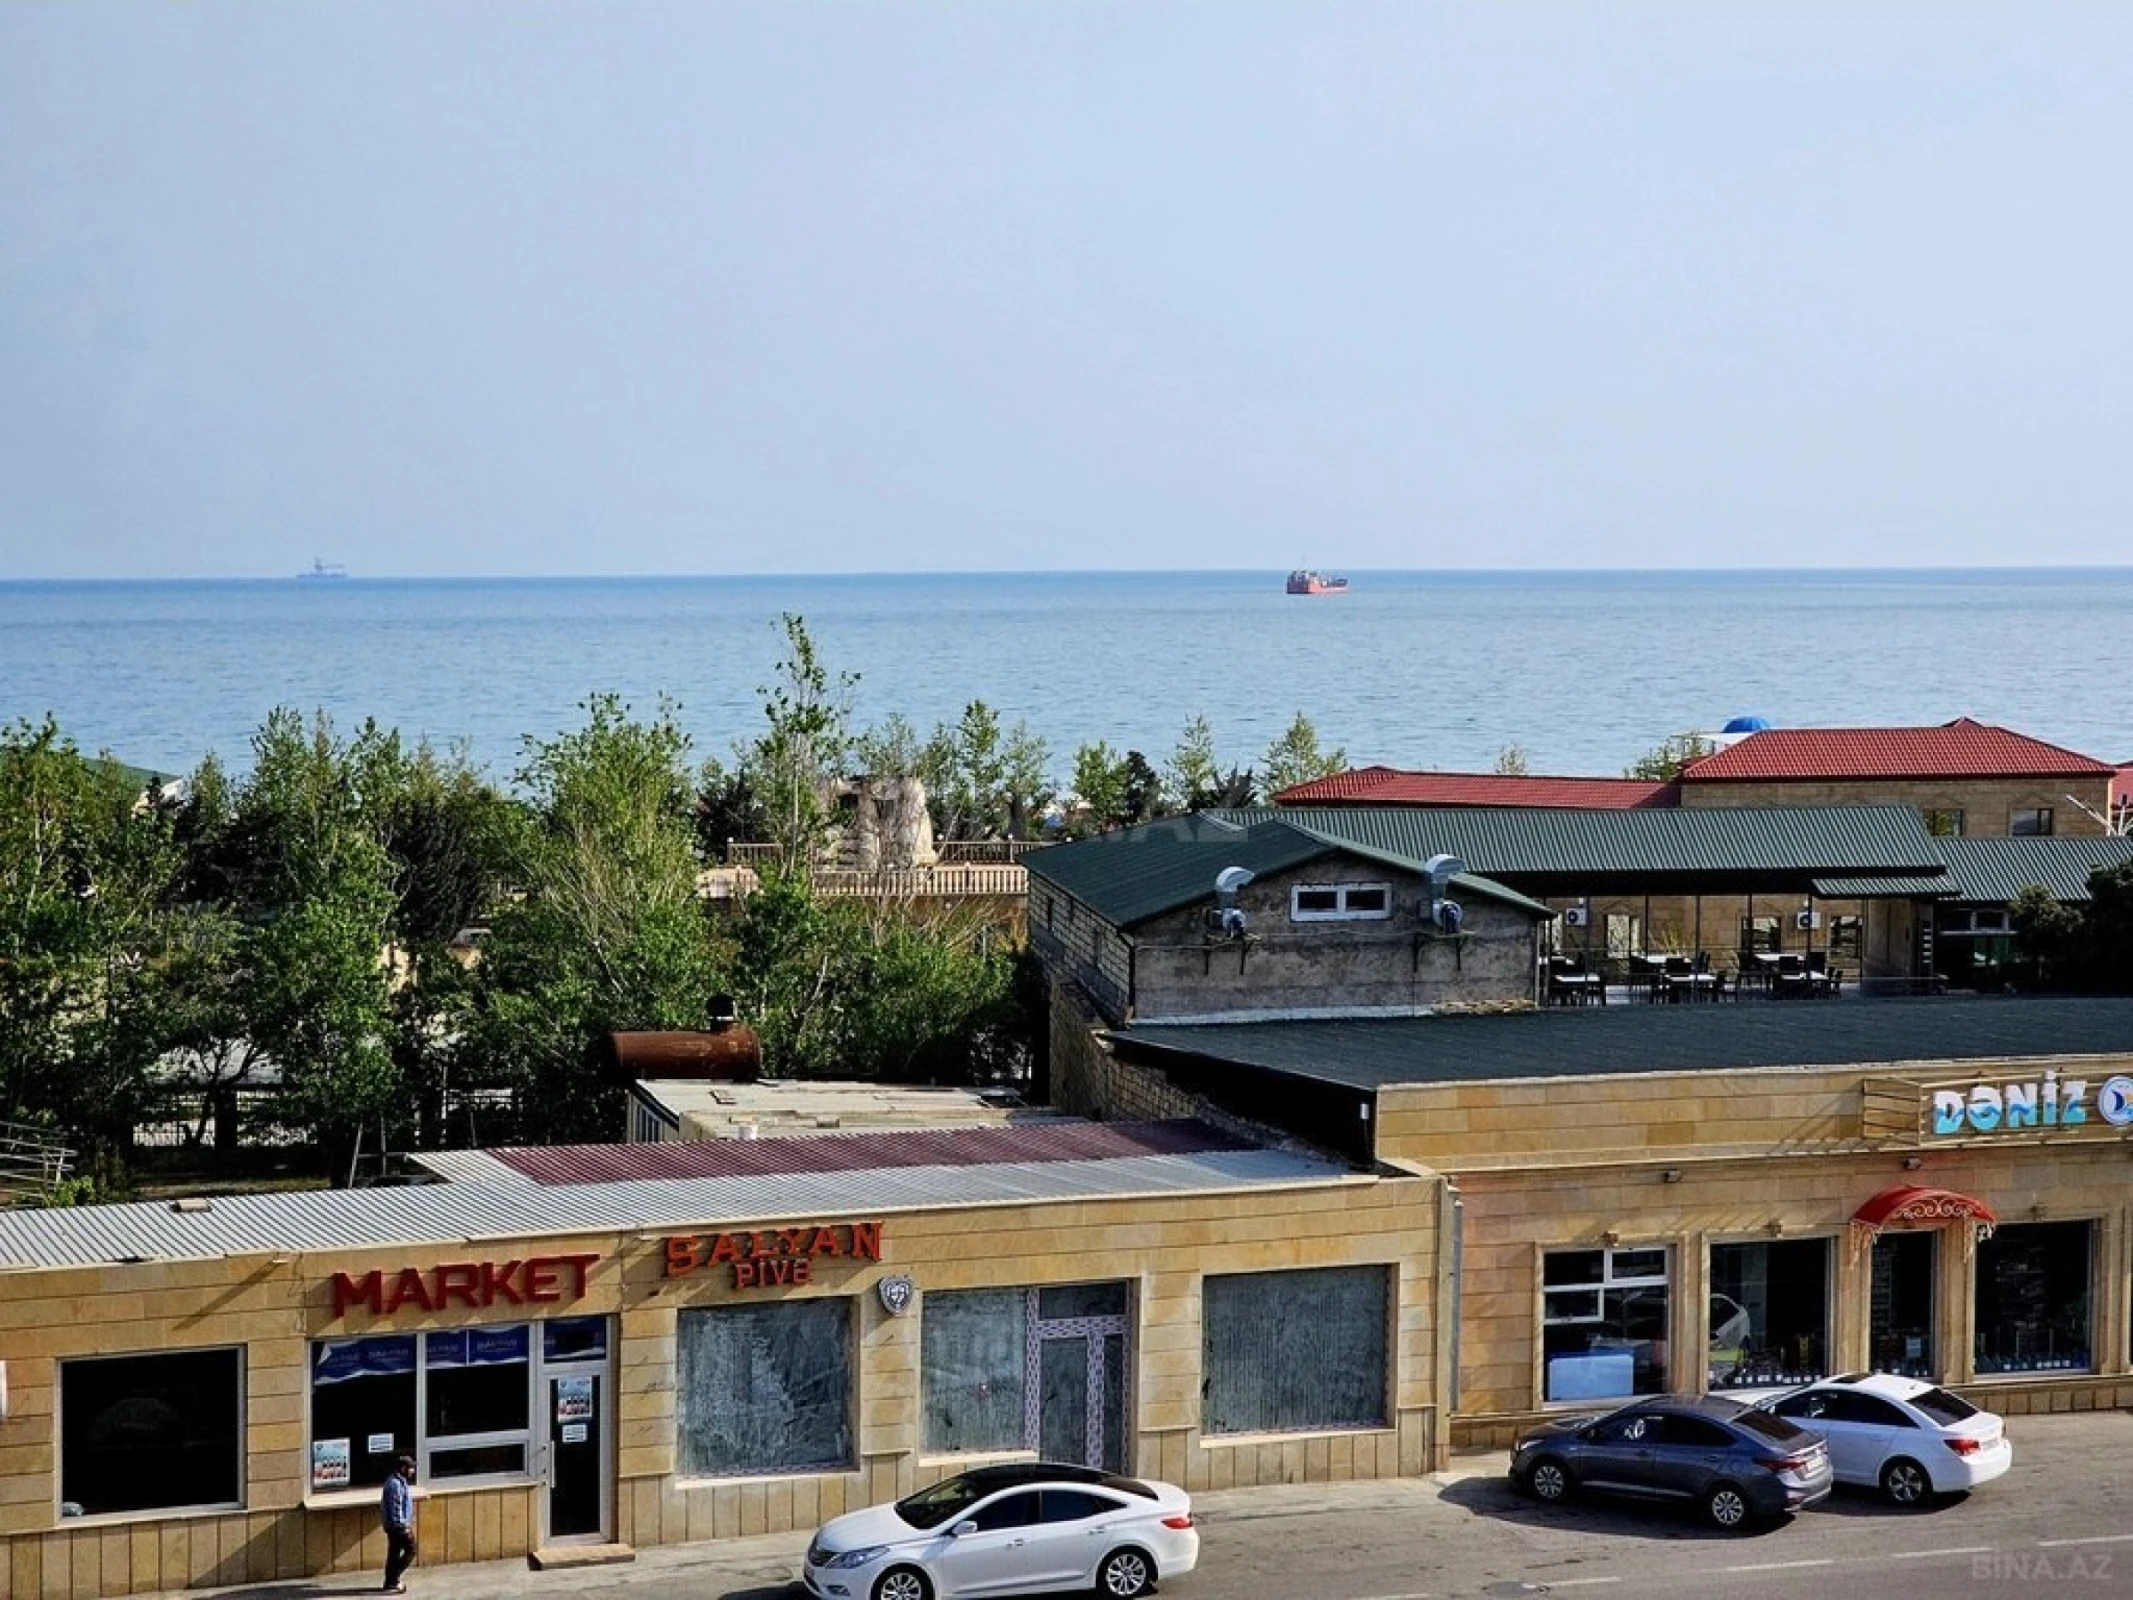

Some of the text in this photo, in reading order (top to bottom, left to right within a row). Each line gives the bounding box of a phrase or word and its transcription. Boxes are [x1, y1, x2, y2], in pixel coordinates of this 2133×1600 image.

[1932, 1070, 2088, 1135] DƏNİZ
[665, 1221, 883, 1277] SALYAN
[331, 1253, 600, 1318] MARKET
